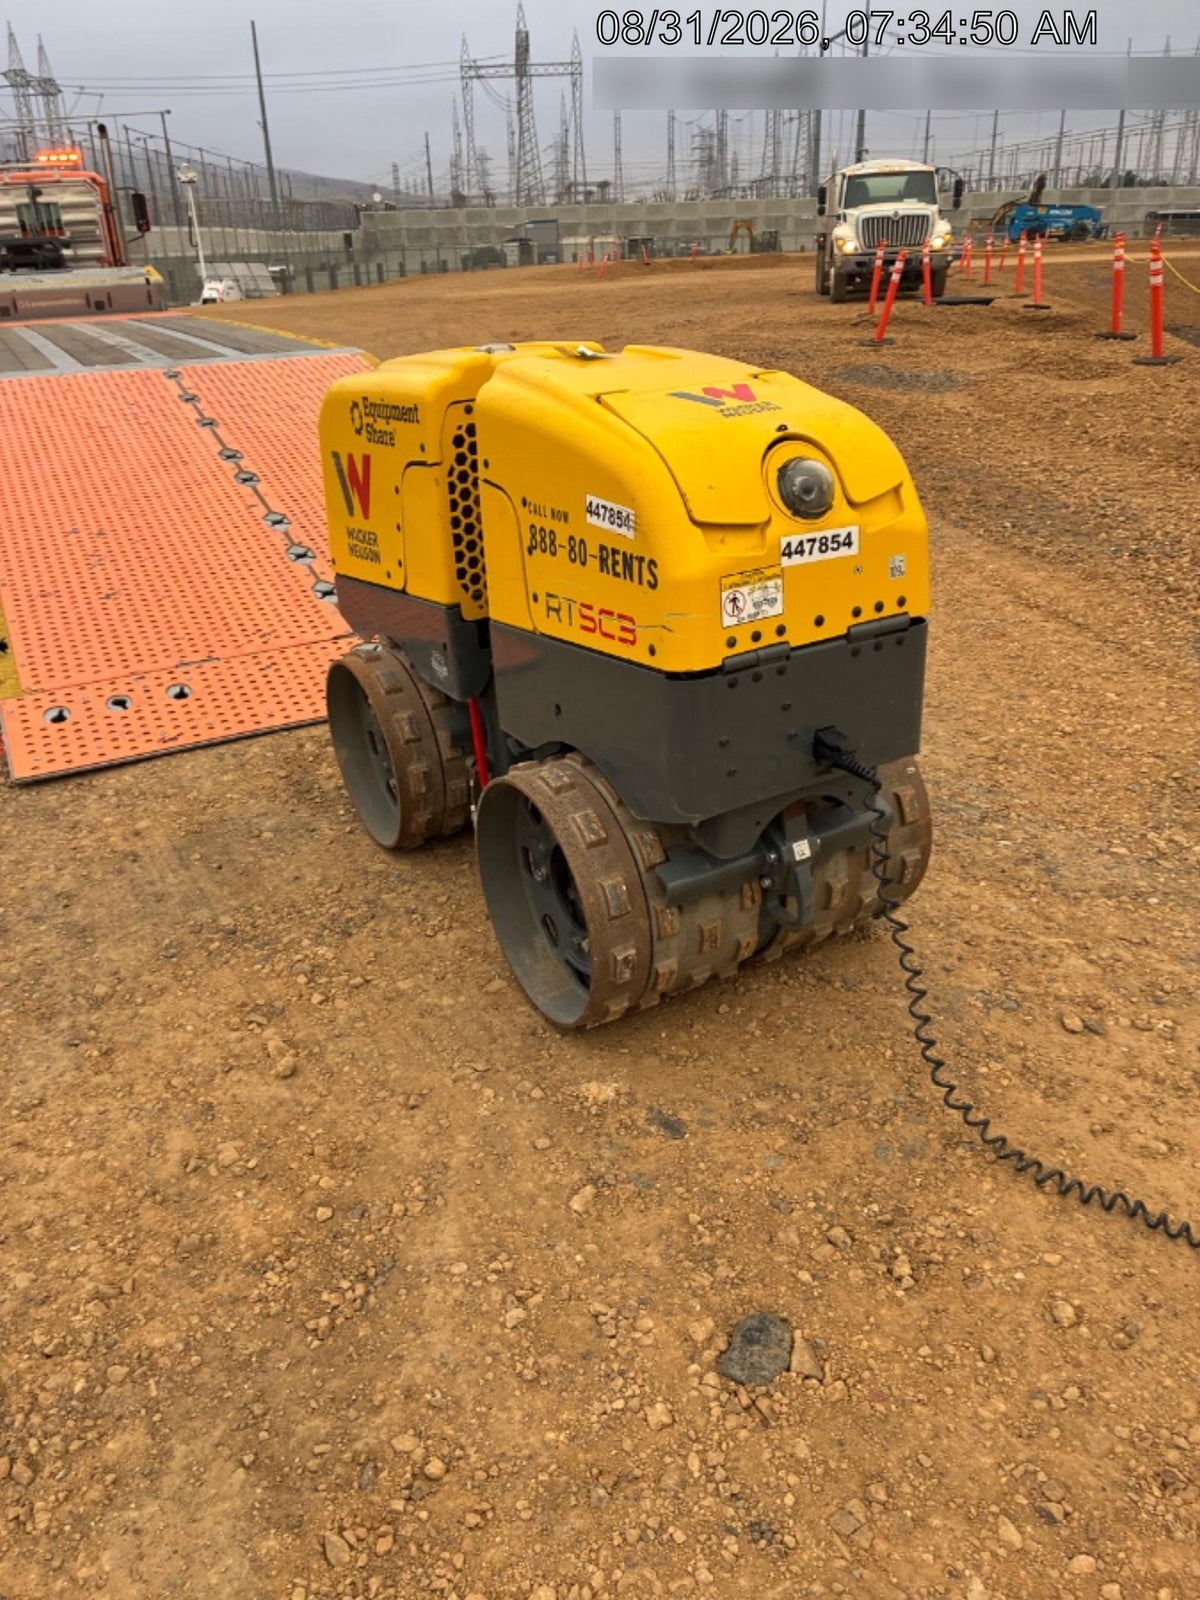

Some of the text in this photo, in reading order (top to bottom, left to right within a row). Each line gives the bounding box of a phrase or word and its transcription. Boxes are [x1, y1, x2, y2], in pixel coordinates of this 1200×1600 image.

[362, 396, 420, 425] Equipment
[365, 422, 396, 447] Share
[528, 502, 569, 524] CALL NOW
[586, 500, 631, 532] 447854
[529, 523, 658, 590] 888-80-RENTS
[781, 531, 854, 560] 447854
